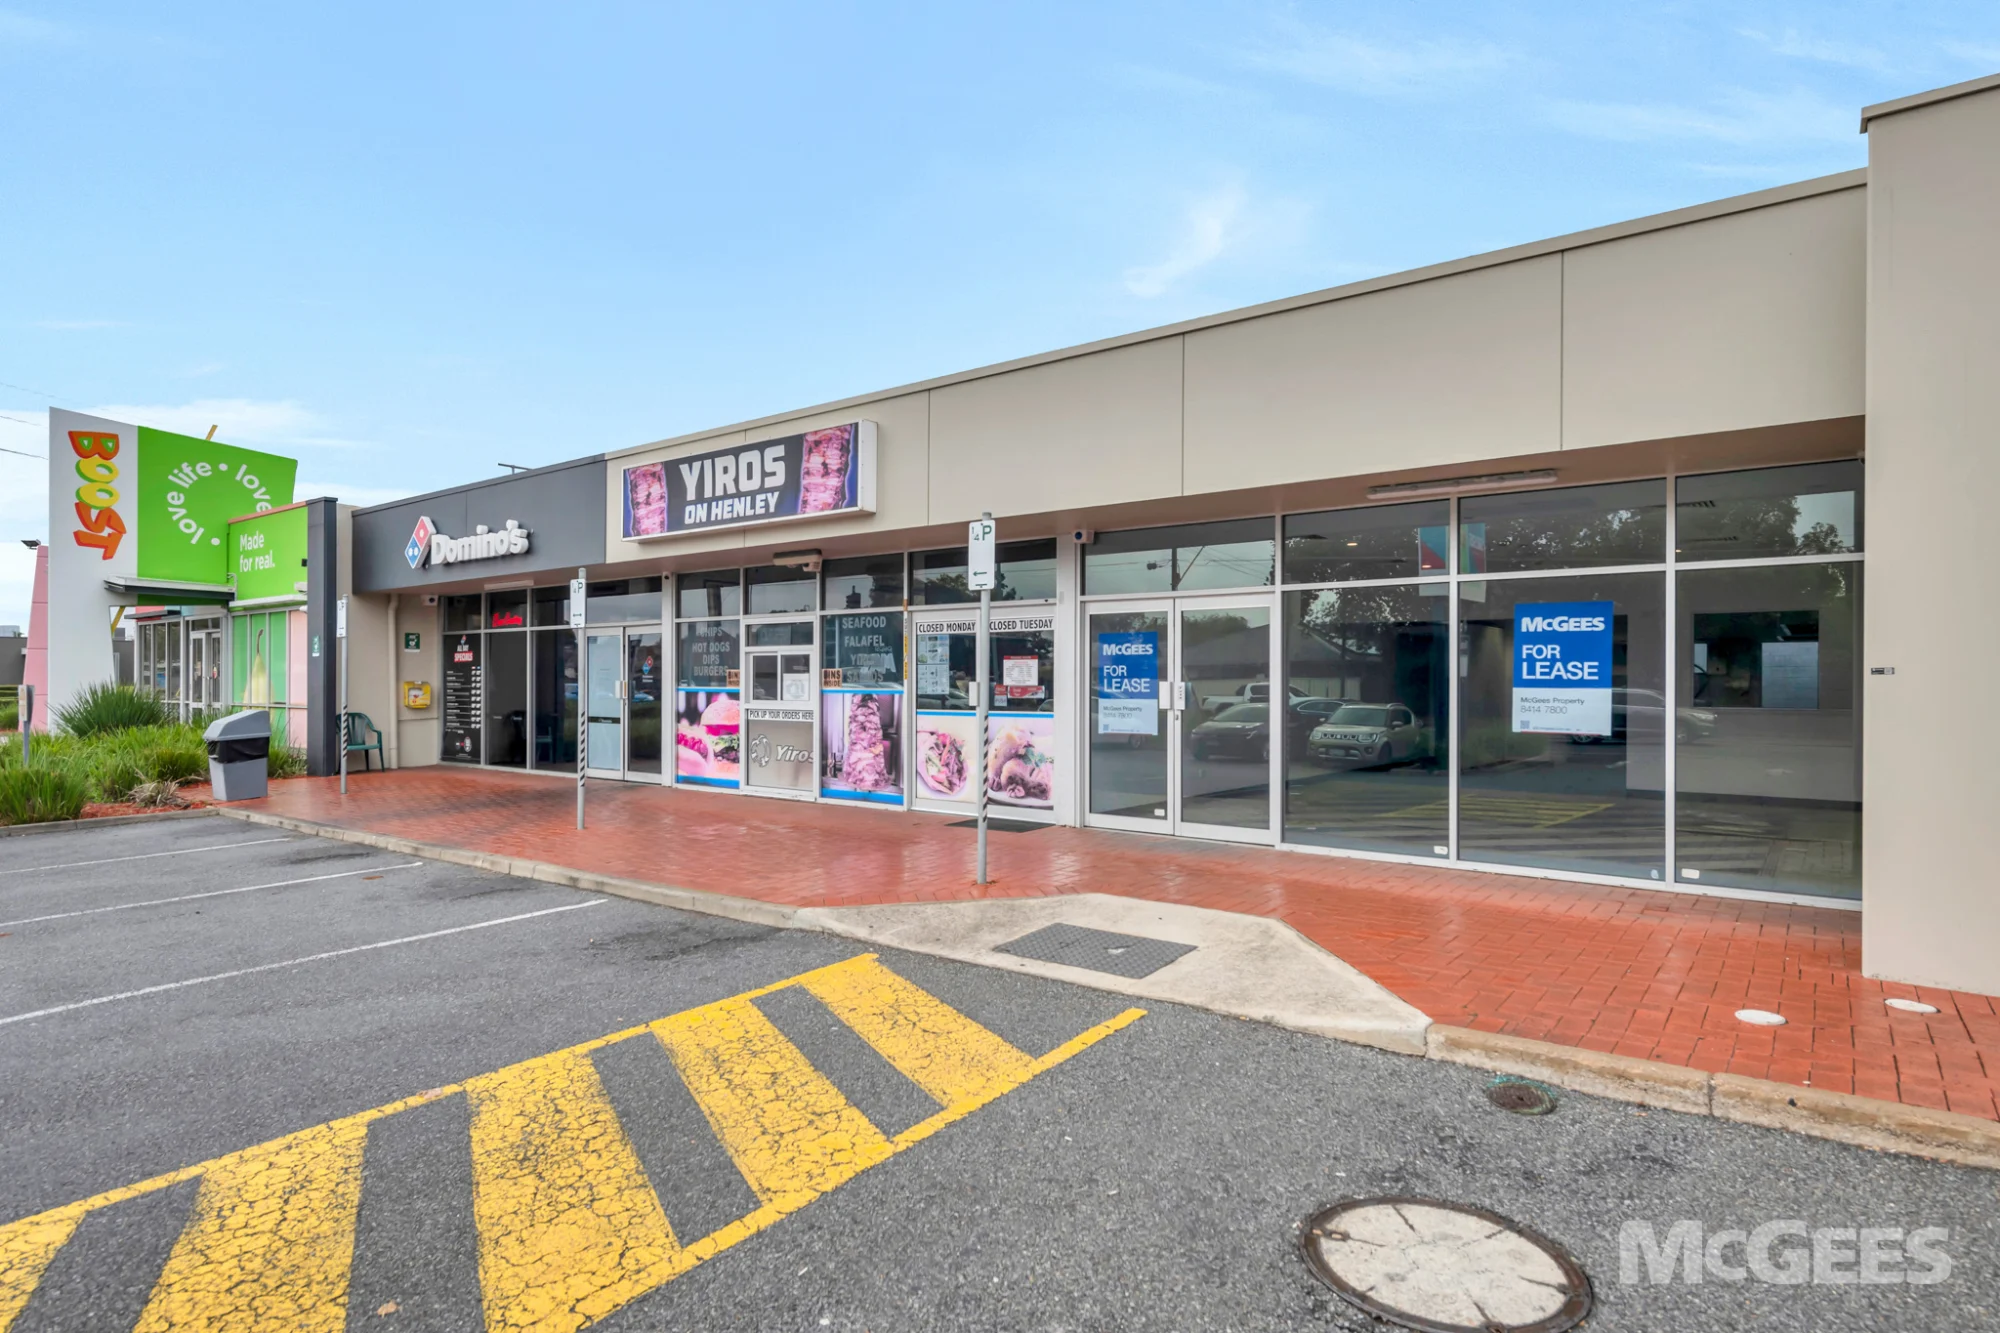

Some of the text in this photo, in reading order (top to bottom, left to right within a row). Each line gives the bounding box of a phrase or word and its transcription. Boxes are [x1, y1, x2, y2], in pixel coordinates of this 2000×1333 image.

[679, 444, 786, 501] YIROS
[68, 430, 127, 561] BOOST
[167, 462, 212, 545] love life
[684, 491, 780, 525] ON HENLEY
[240, 530, 265, 552] Made
[431, 519, 529, 565] Domino's
[240, 549, 276, 573] for real.
[842, 616, 886, 629] SEAFOOD
[919, 621, 976, 633] CLOSED MONDAY
[989, 618, 1053, 631] CLOSED TUESDAY
[1521, 615, 1606, 633] McGEES
[692, 641, 730, 653] HOT DOGS
[844, 634, 885, 648] FALAFEL
[1103, 643, 1154, 656] McGEES
[1522, 644, 1561, 659] FOR
[702, 654, 720, 665] DIPS
[693, 665, 728, 677] BURGERS
[823, 669, 841, 680] BINS
[1103, 665, 1127, 677] FOR
[1522, 661, 1599, 680] LEASE
[1103, 678, 1151, 693] LEASE
[1552, 697, 1585, 705] Property
[749, 710, 814, 720] PICK UP YOUR ORDERS HERE
[1520, 705, 1568, 715] 8414 7800
